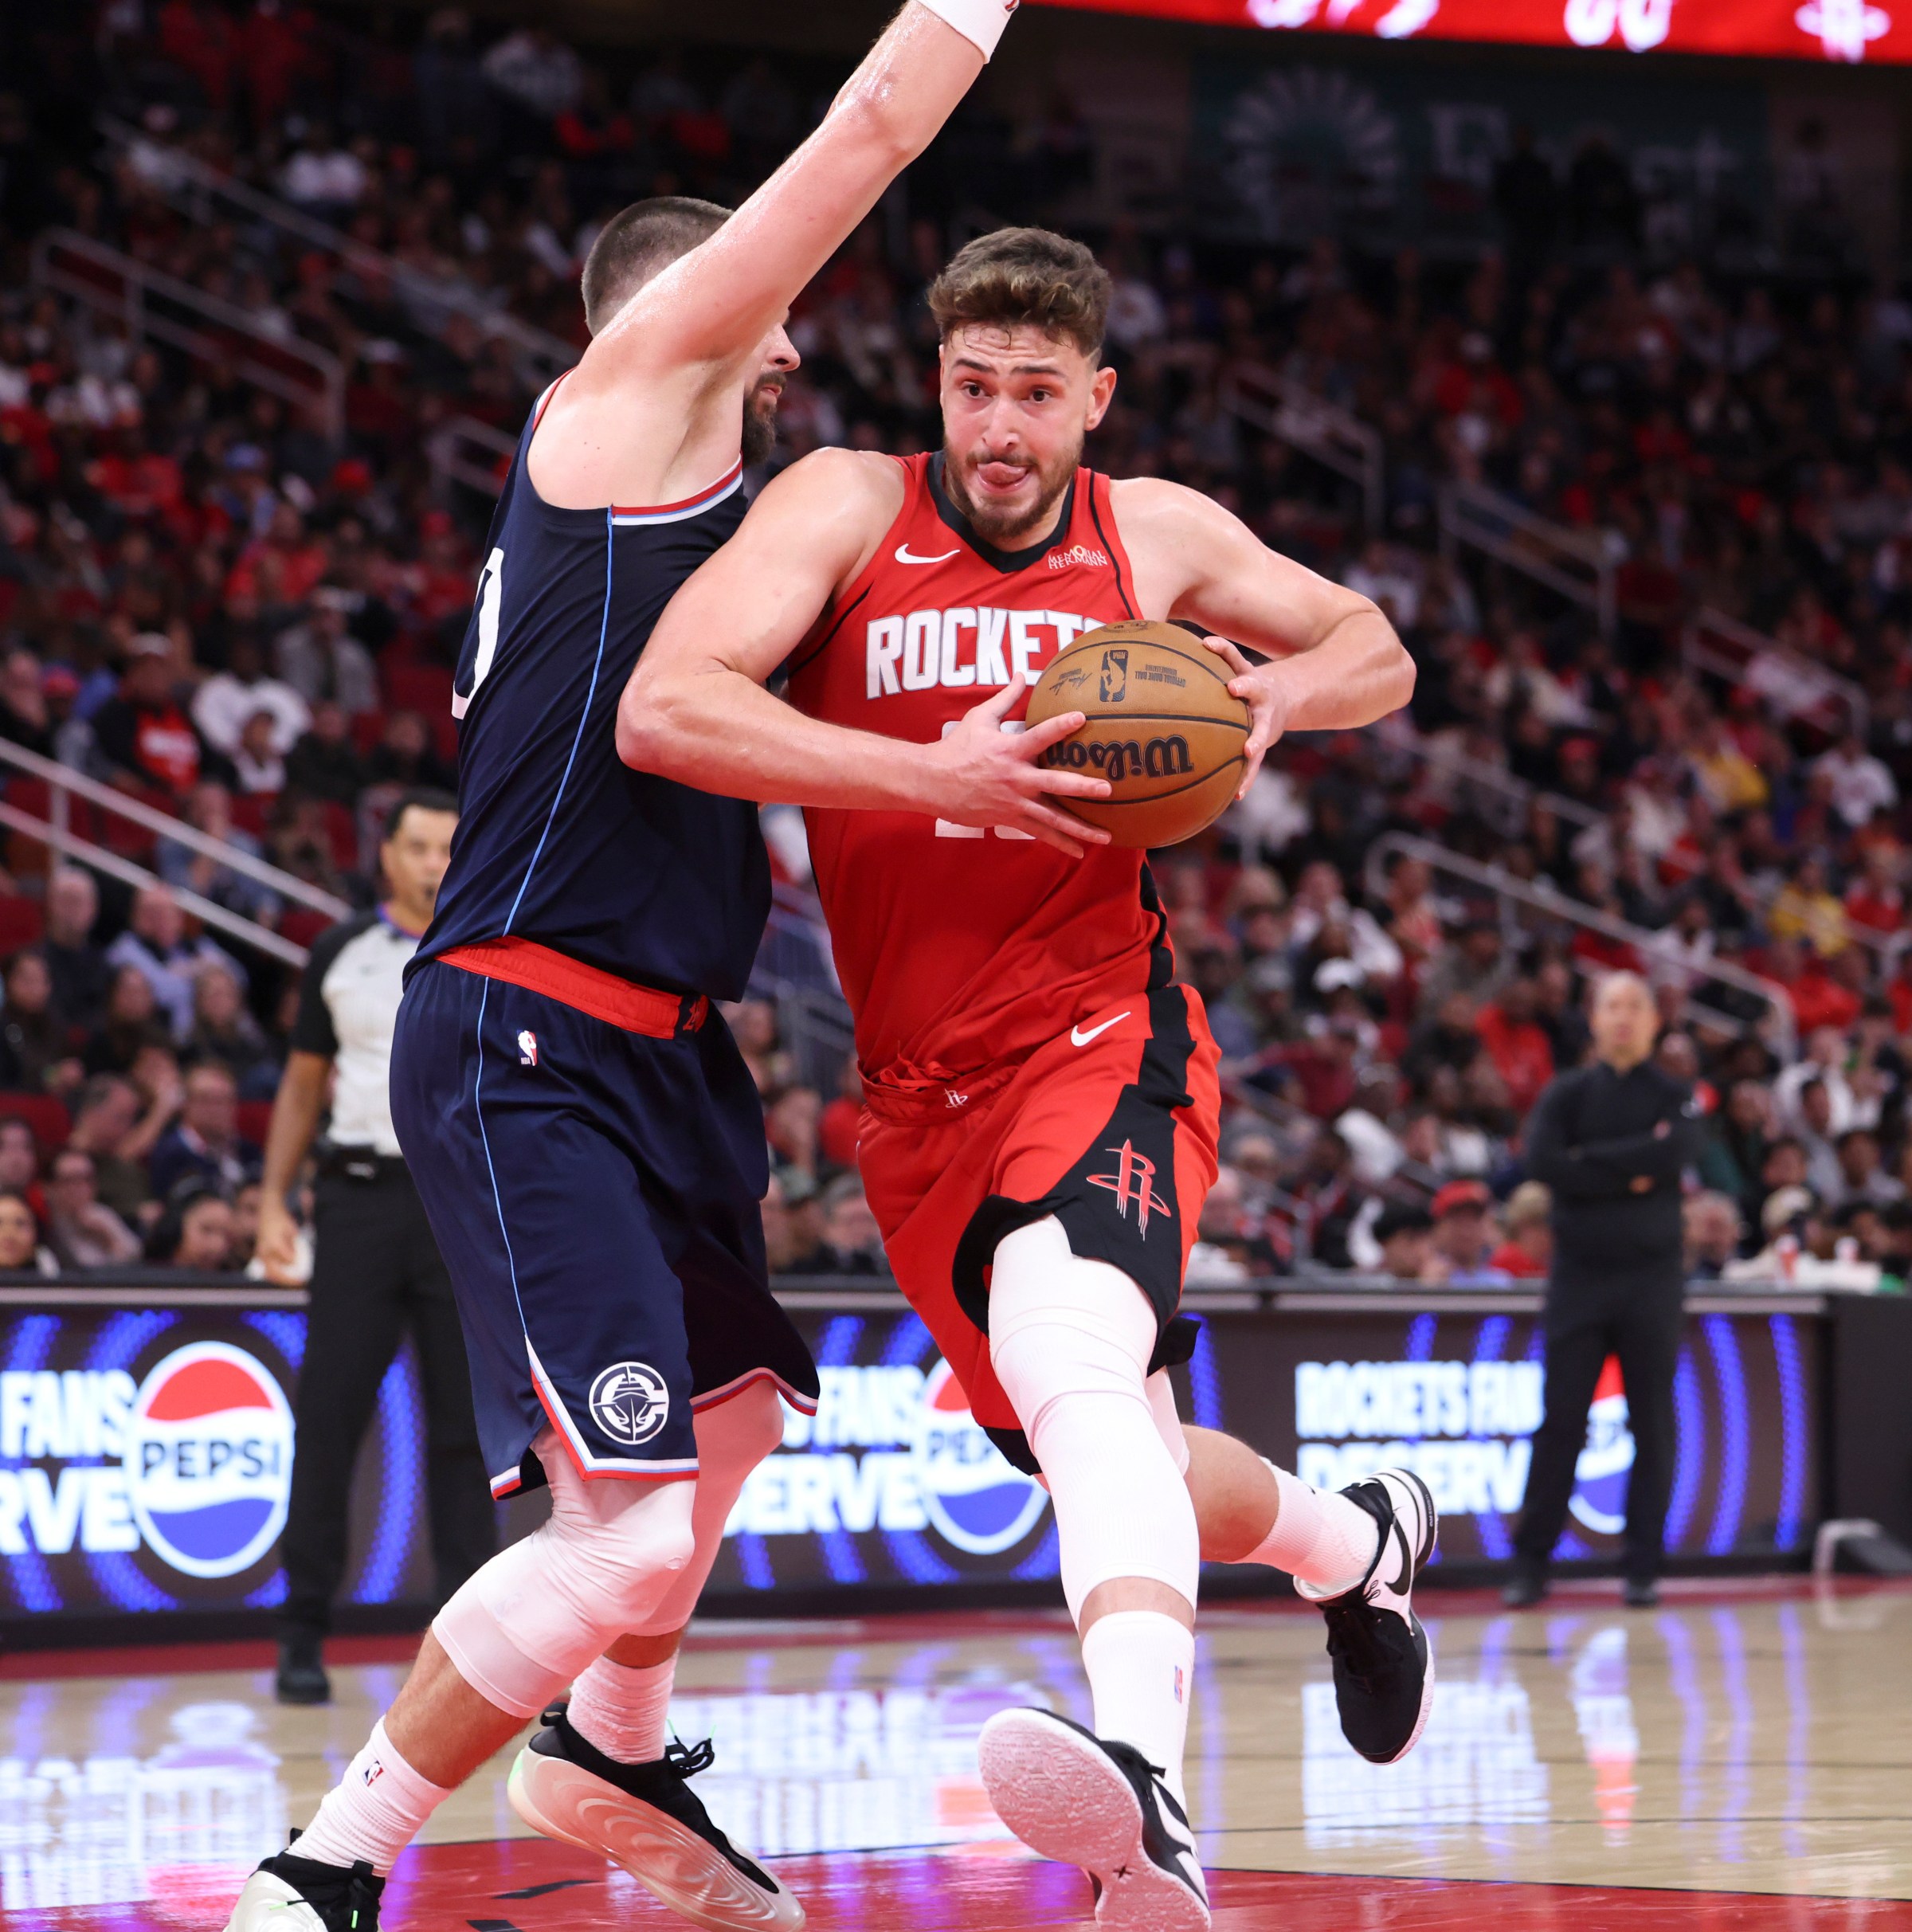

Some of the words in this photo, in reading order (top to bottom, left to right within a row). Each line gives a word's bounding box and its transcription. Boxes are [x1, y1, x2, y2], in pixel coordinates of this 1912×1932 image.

[866, 605, 1107, 700] ROCKET
[1045, 735, 1195, 782] Wilson
[0, 1370, 139, 1457] FANS
[1469, 1359, 1546, 1435] FAN
[142, 1440, 280, 1478] PEPSI
